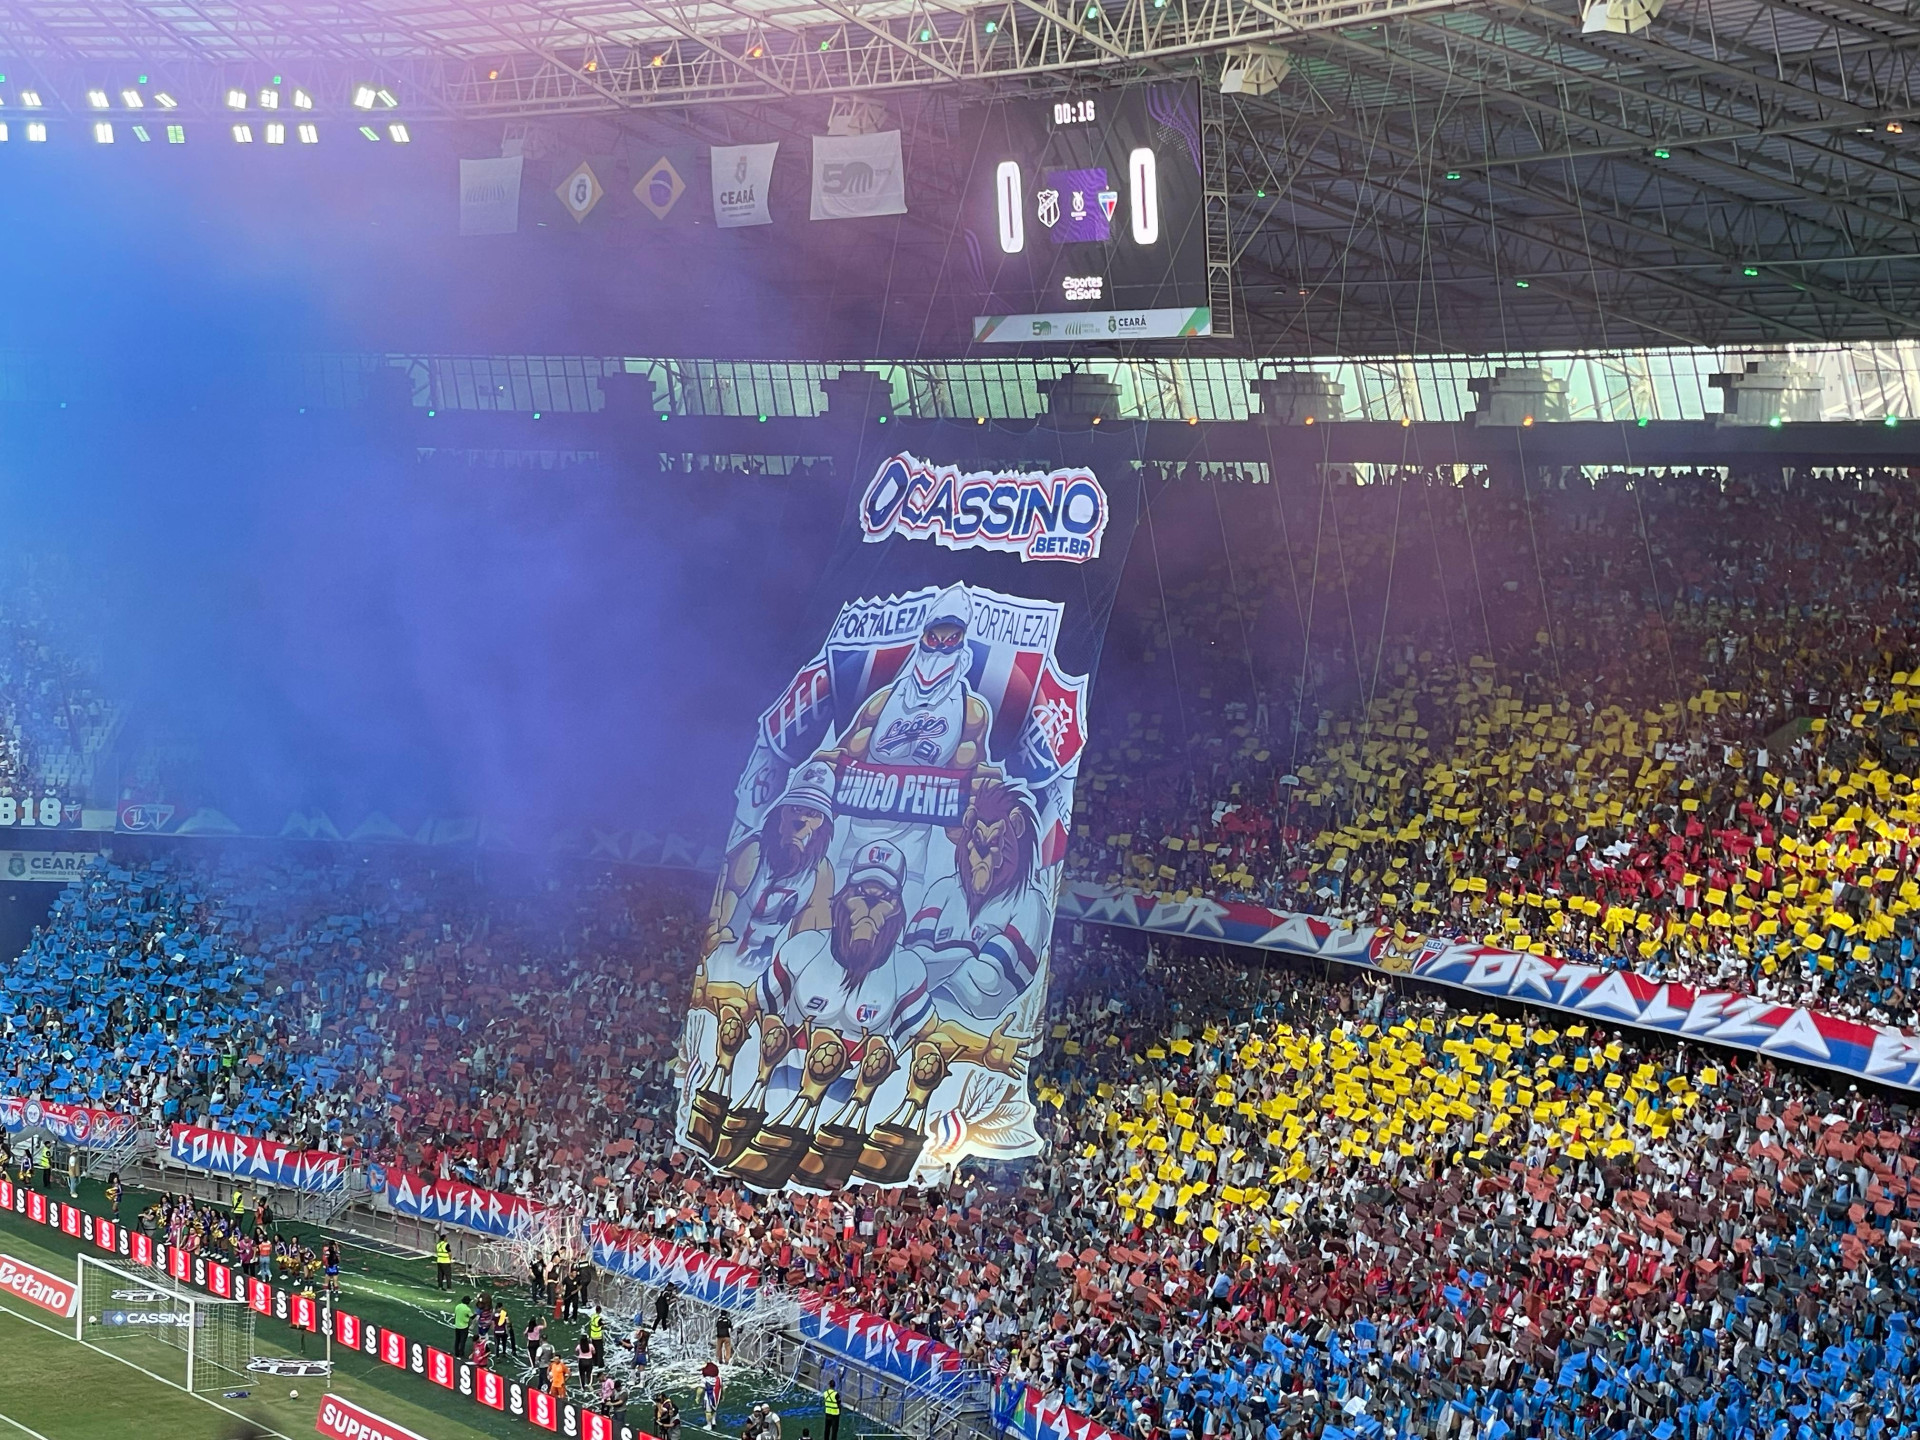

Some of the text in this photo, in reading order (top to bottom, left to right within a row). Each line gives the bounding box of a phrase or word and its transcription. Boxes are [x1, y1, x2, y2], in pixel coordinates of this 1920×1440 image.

[1054, 100, 1095, 124] 00:16
[720, 185, 755, 205] CEARÁ
[997, 161, 1024, 253] 0
[1129, 148, 1159, 244] 0
[1063, 276, 1102, 290] Esportes
[1119, 315, 1146, 327] CEARÁ
[833, 604, 927, 639] FORTALEZA
[837, 760, 960, 817] ÚNICO PENTA
[31, 855, 87, 871] CEARÁ
[1253, 916, 1380, 959] AO
[1424, 943, 1832, 1060] FORTALEZA
[177, 1129, 340, 1190] COMBATIVO
[0, 1262, 67, 1309] Betano
[846, 1312, 947, 1387] FORTE
[322, 1403, 394, 1440] SUPE
